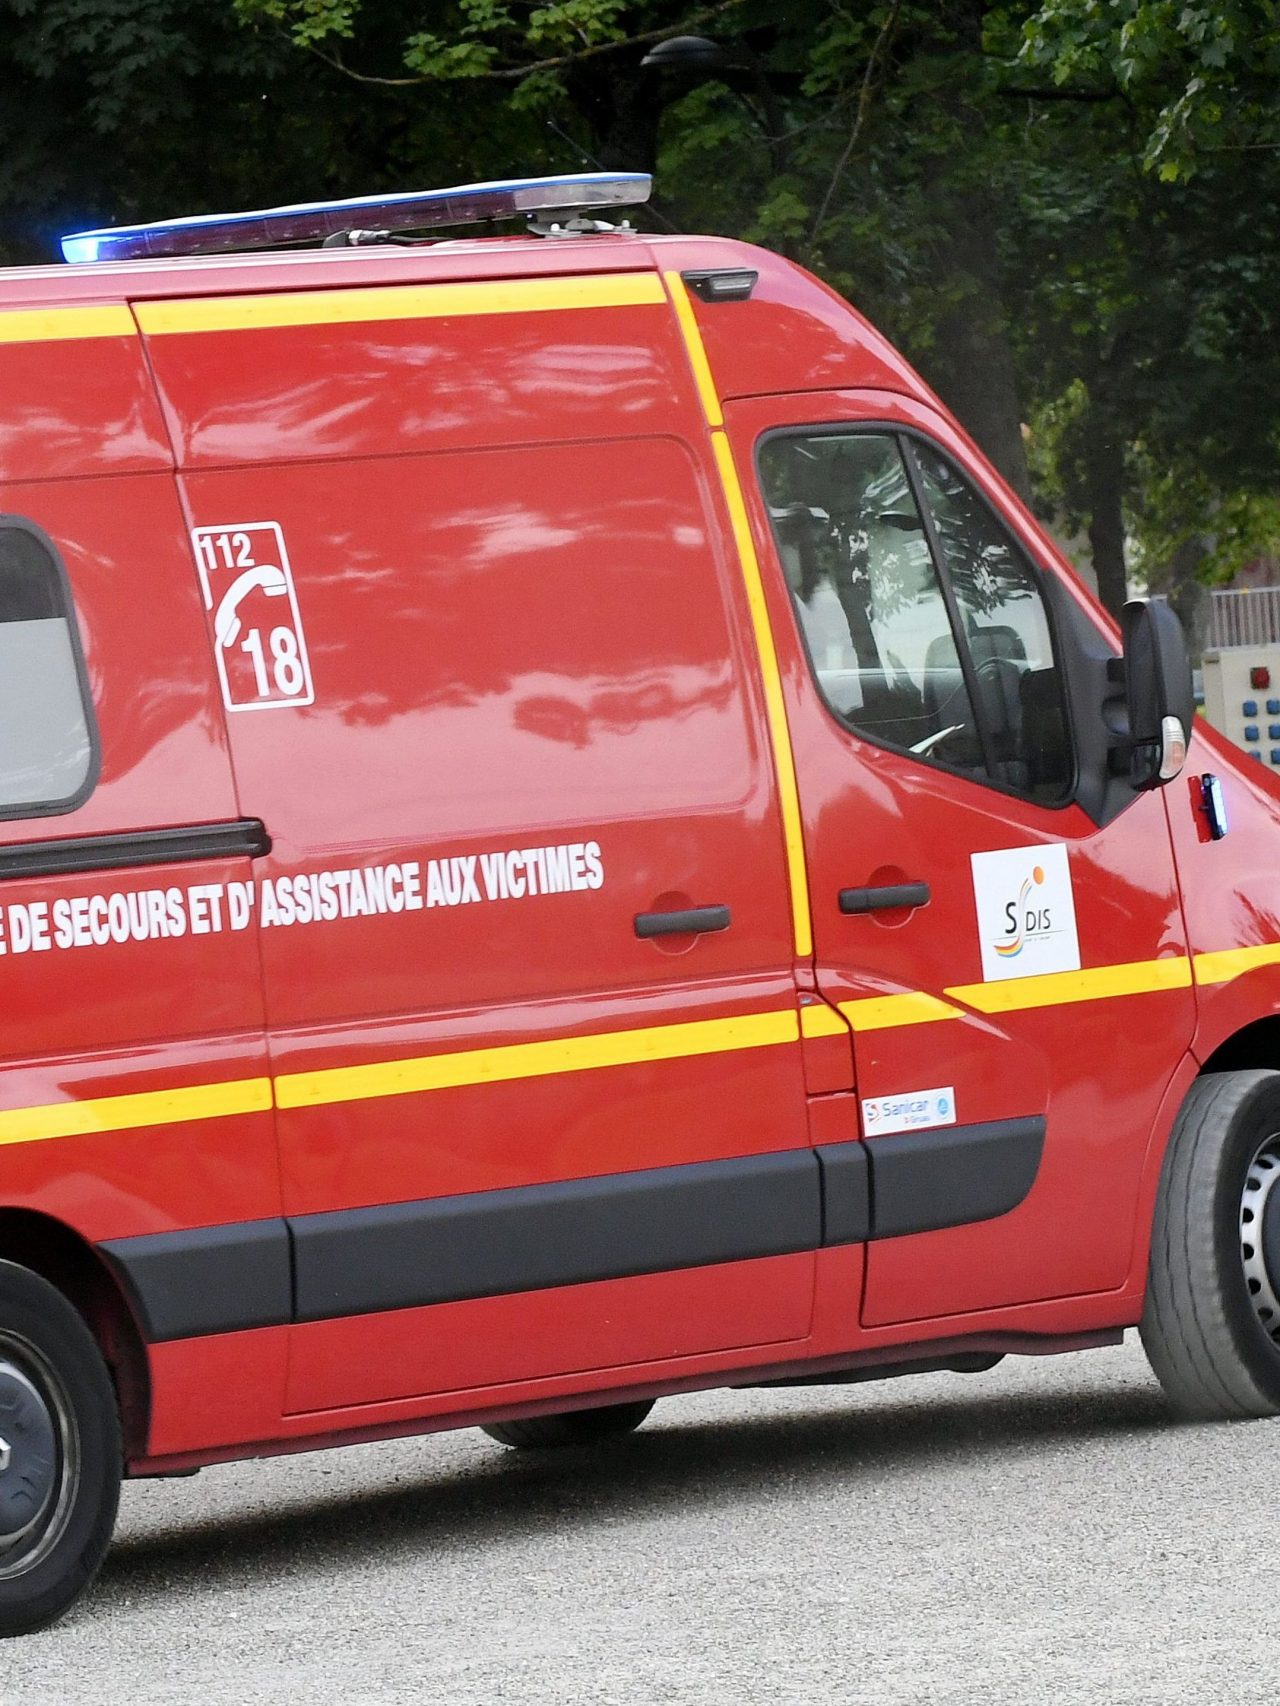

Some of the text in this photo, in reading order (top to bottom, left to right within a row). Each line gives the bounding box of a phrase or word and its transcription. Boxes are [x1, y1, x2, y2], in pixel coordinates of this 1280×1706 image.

[199, 533, 255, 570] 112
[241, 626, 304, 696] 18
[8, 901, 52, 954] DE
[52, 887, 187, 949] SECOURS
[187, 883, 224, 934] ET
[260, 861, 423, 928] ASSISTANCE
[426, 855, 482, 908] AUX
[479, 841, 604, 901] VICTIMES
[882, 1100, 929, 1117] Sanicar
